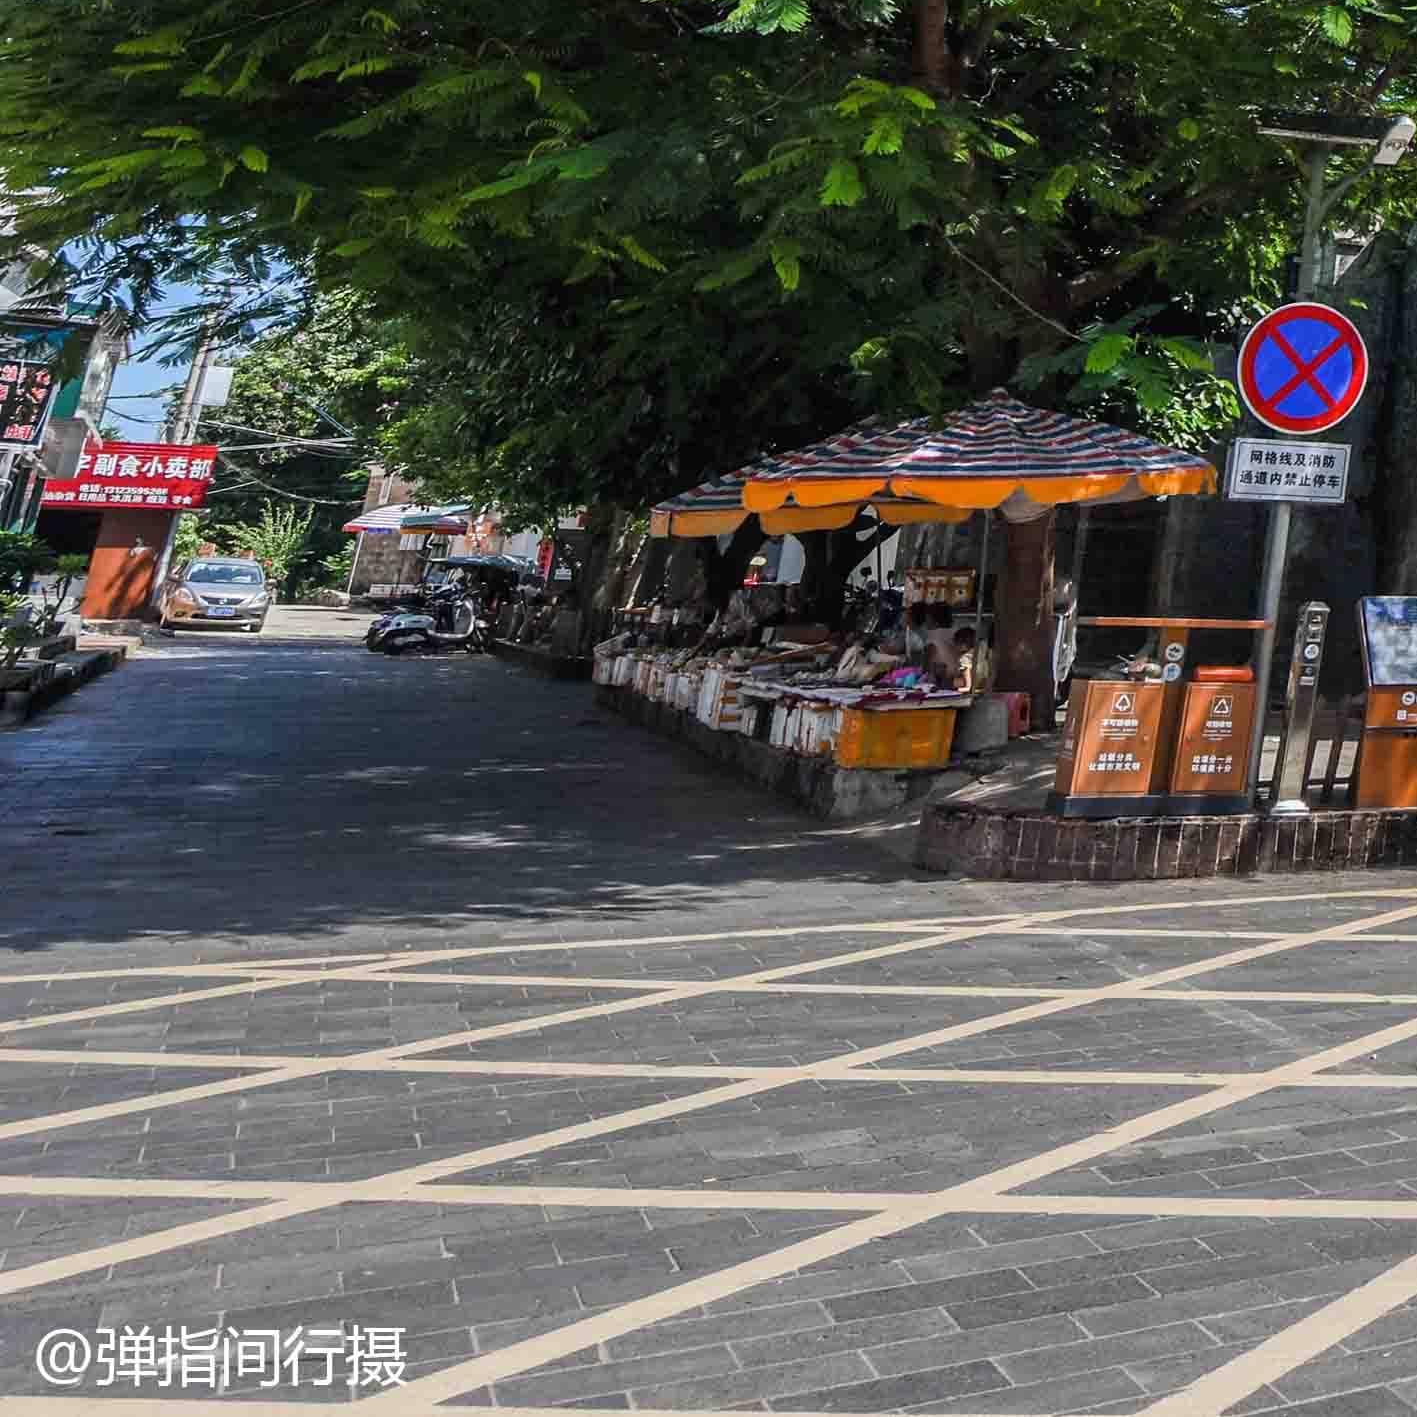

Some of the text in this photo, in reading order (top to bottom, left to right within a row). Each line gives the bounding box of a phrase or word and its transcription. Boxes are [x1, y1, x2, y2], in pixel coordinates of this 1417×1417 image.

[1250, 450, 1336, 469] 网格线及消防
[1240, 470, 1340, 489] 通道内禁止停车
